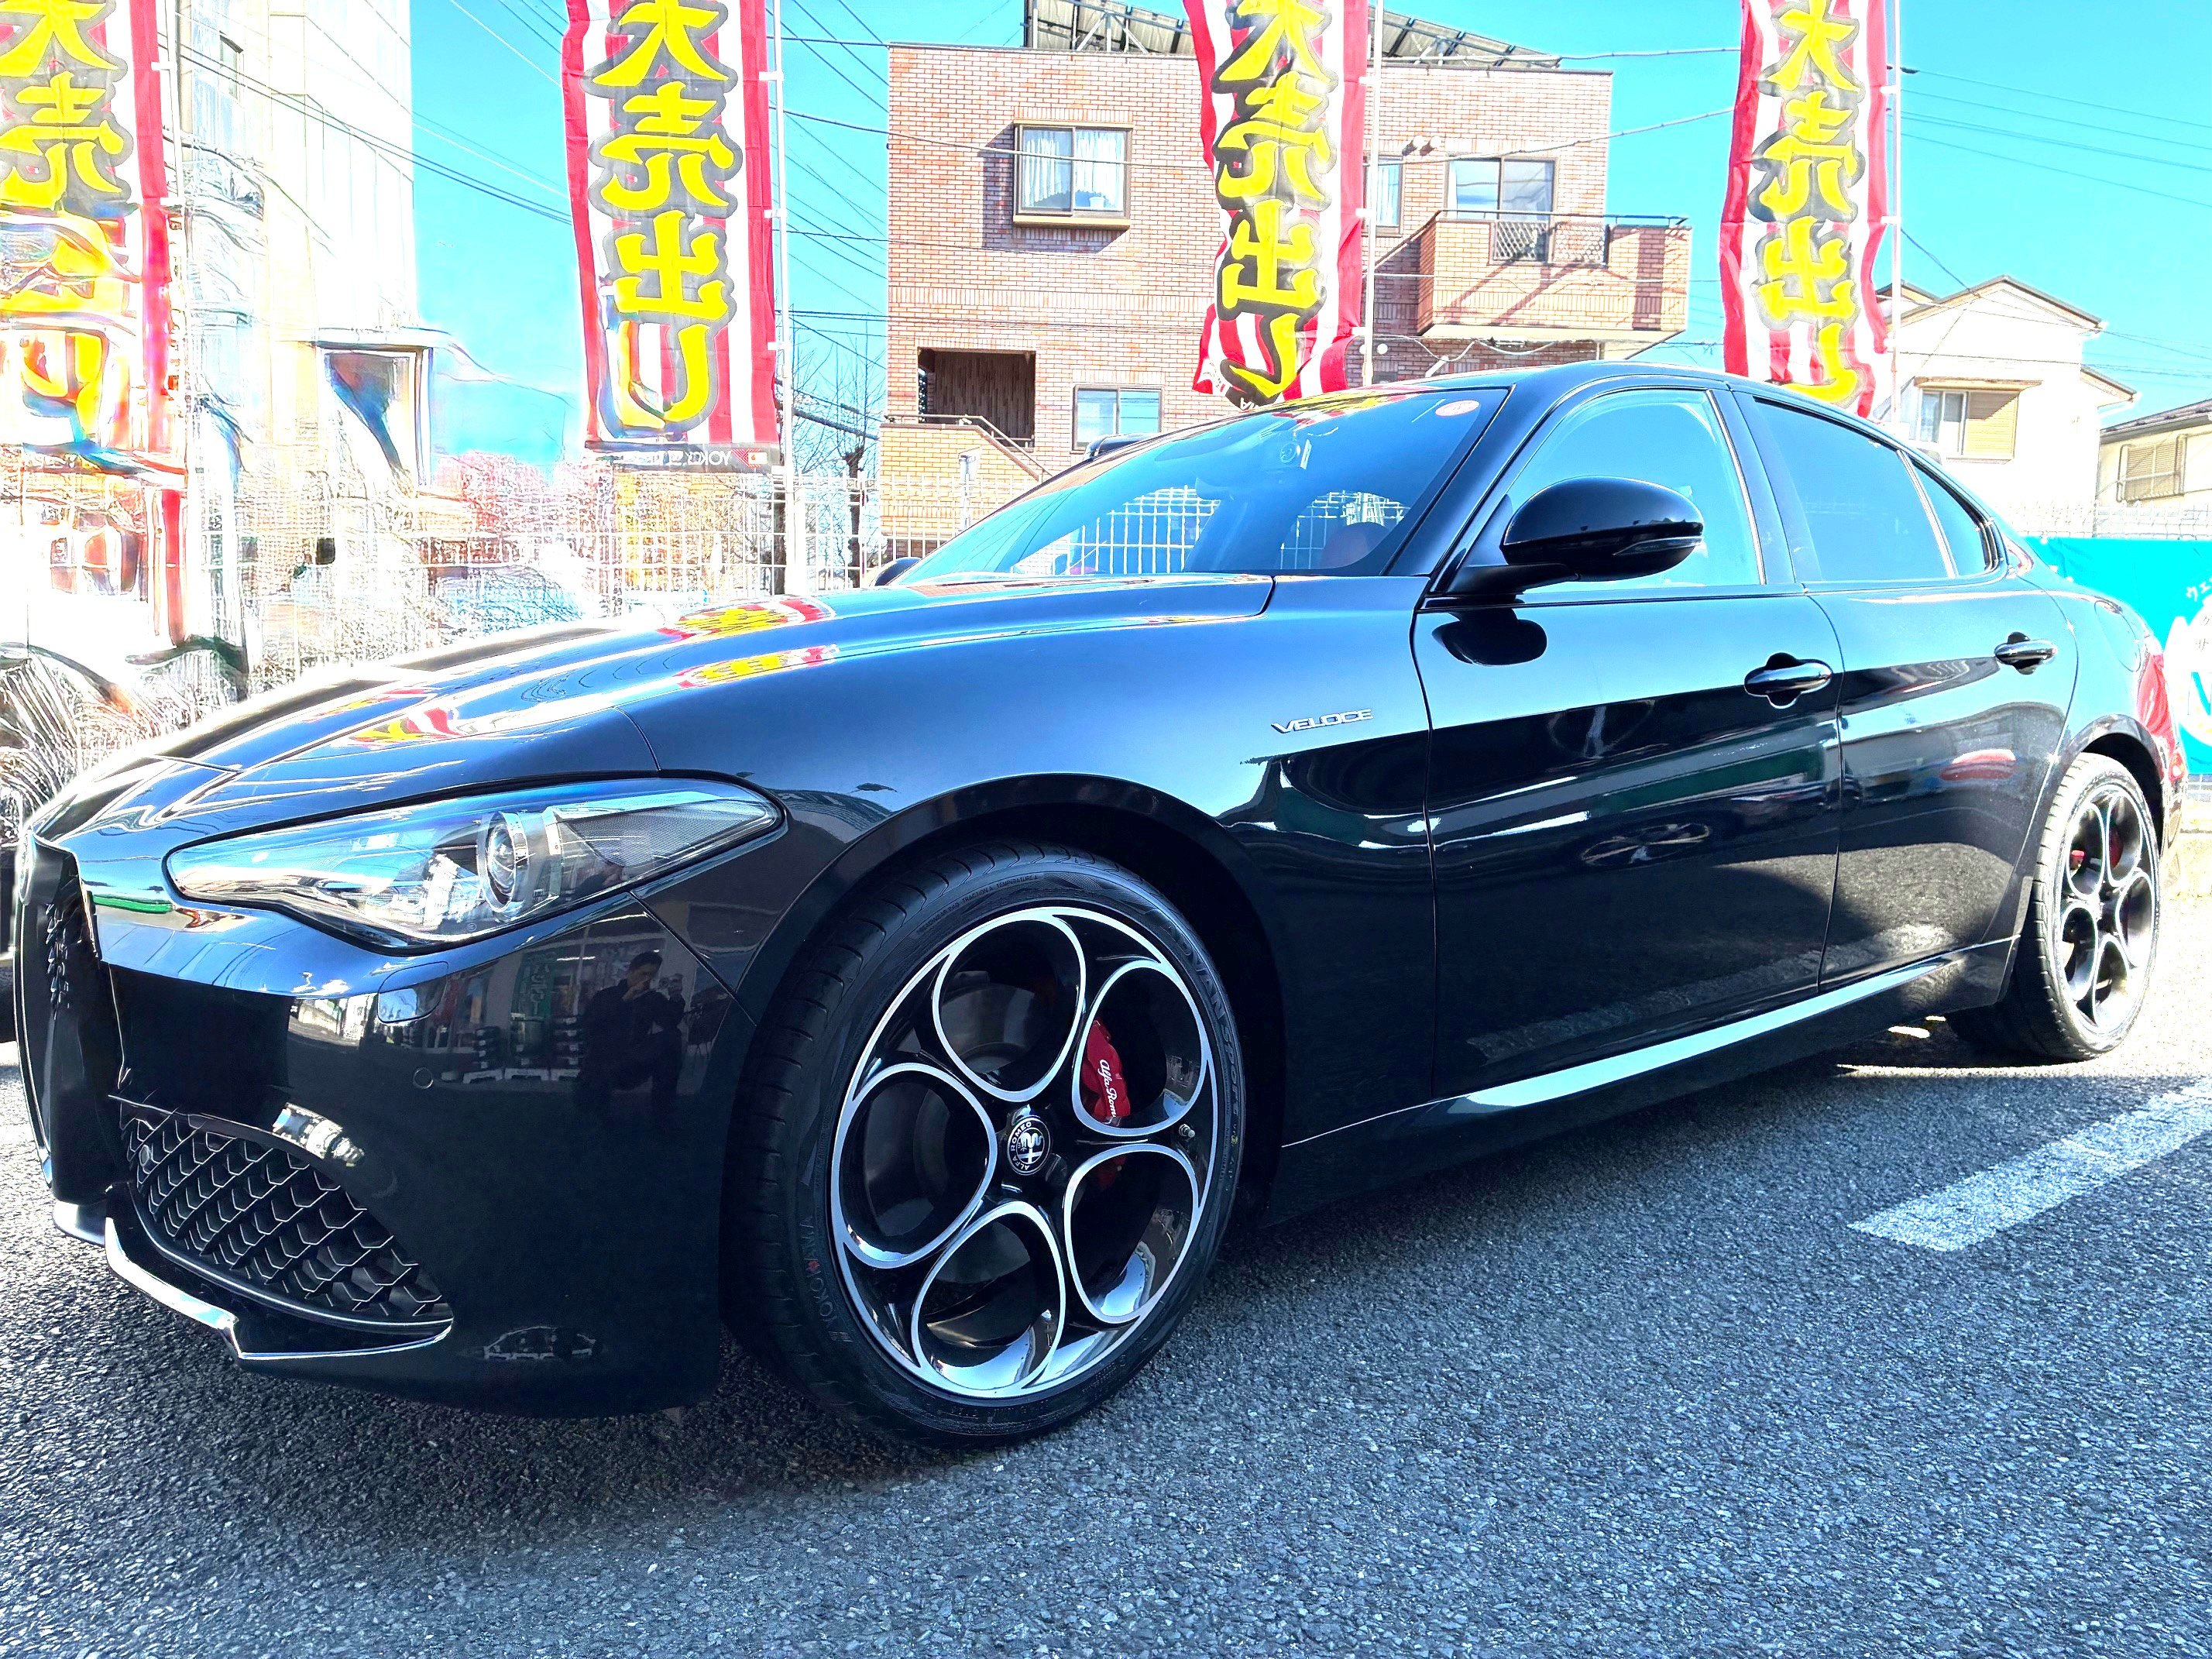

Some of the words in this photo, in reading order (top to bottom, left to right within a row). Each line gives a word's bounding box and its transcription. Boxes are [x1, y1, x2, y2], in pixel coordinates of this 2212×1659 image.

[1270, 708, 1374, 734] VELOCE
[1010, 1121, 1032, 1152] ROMEO
[1012, 1155, 1030, 1170] ALFA
